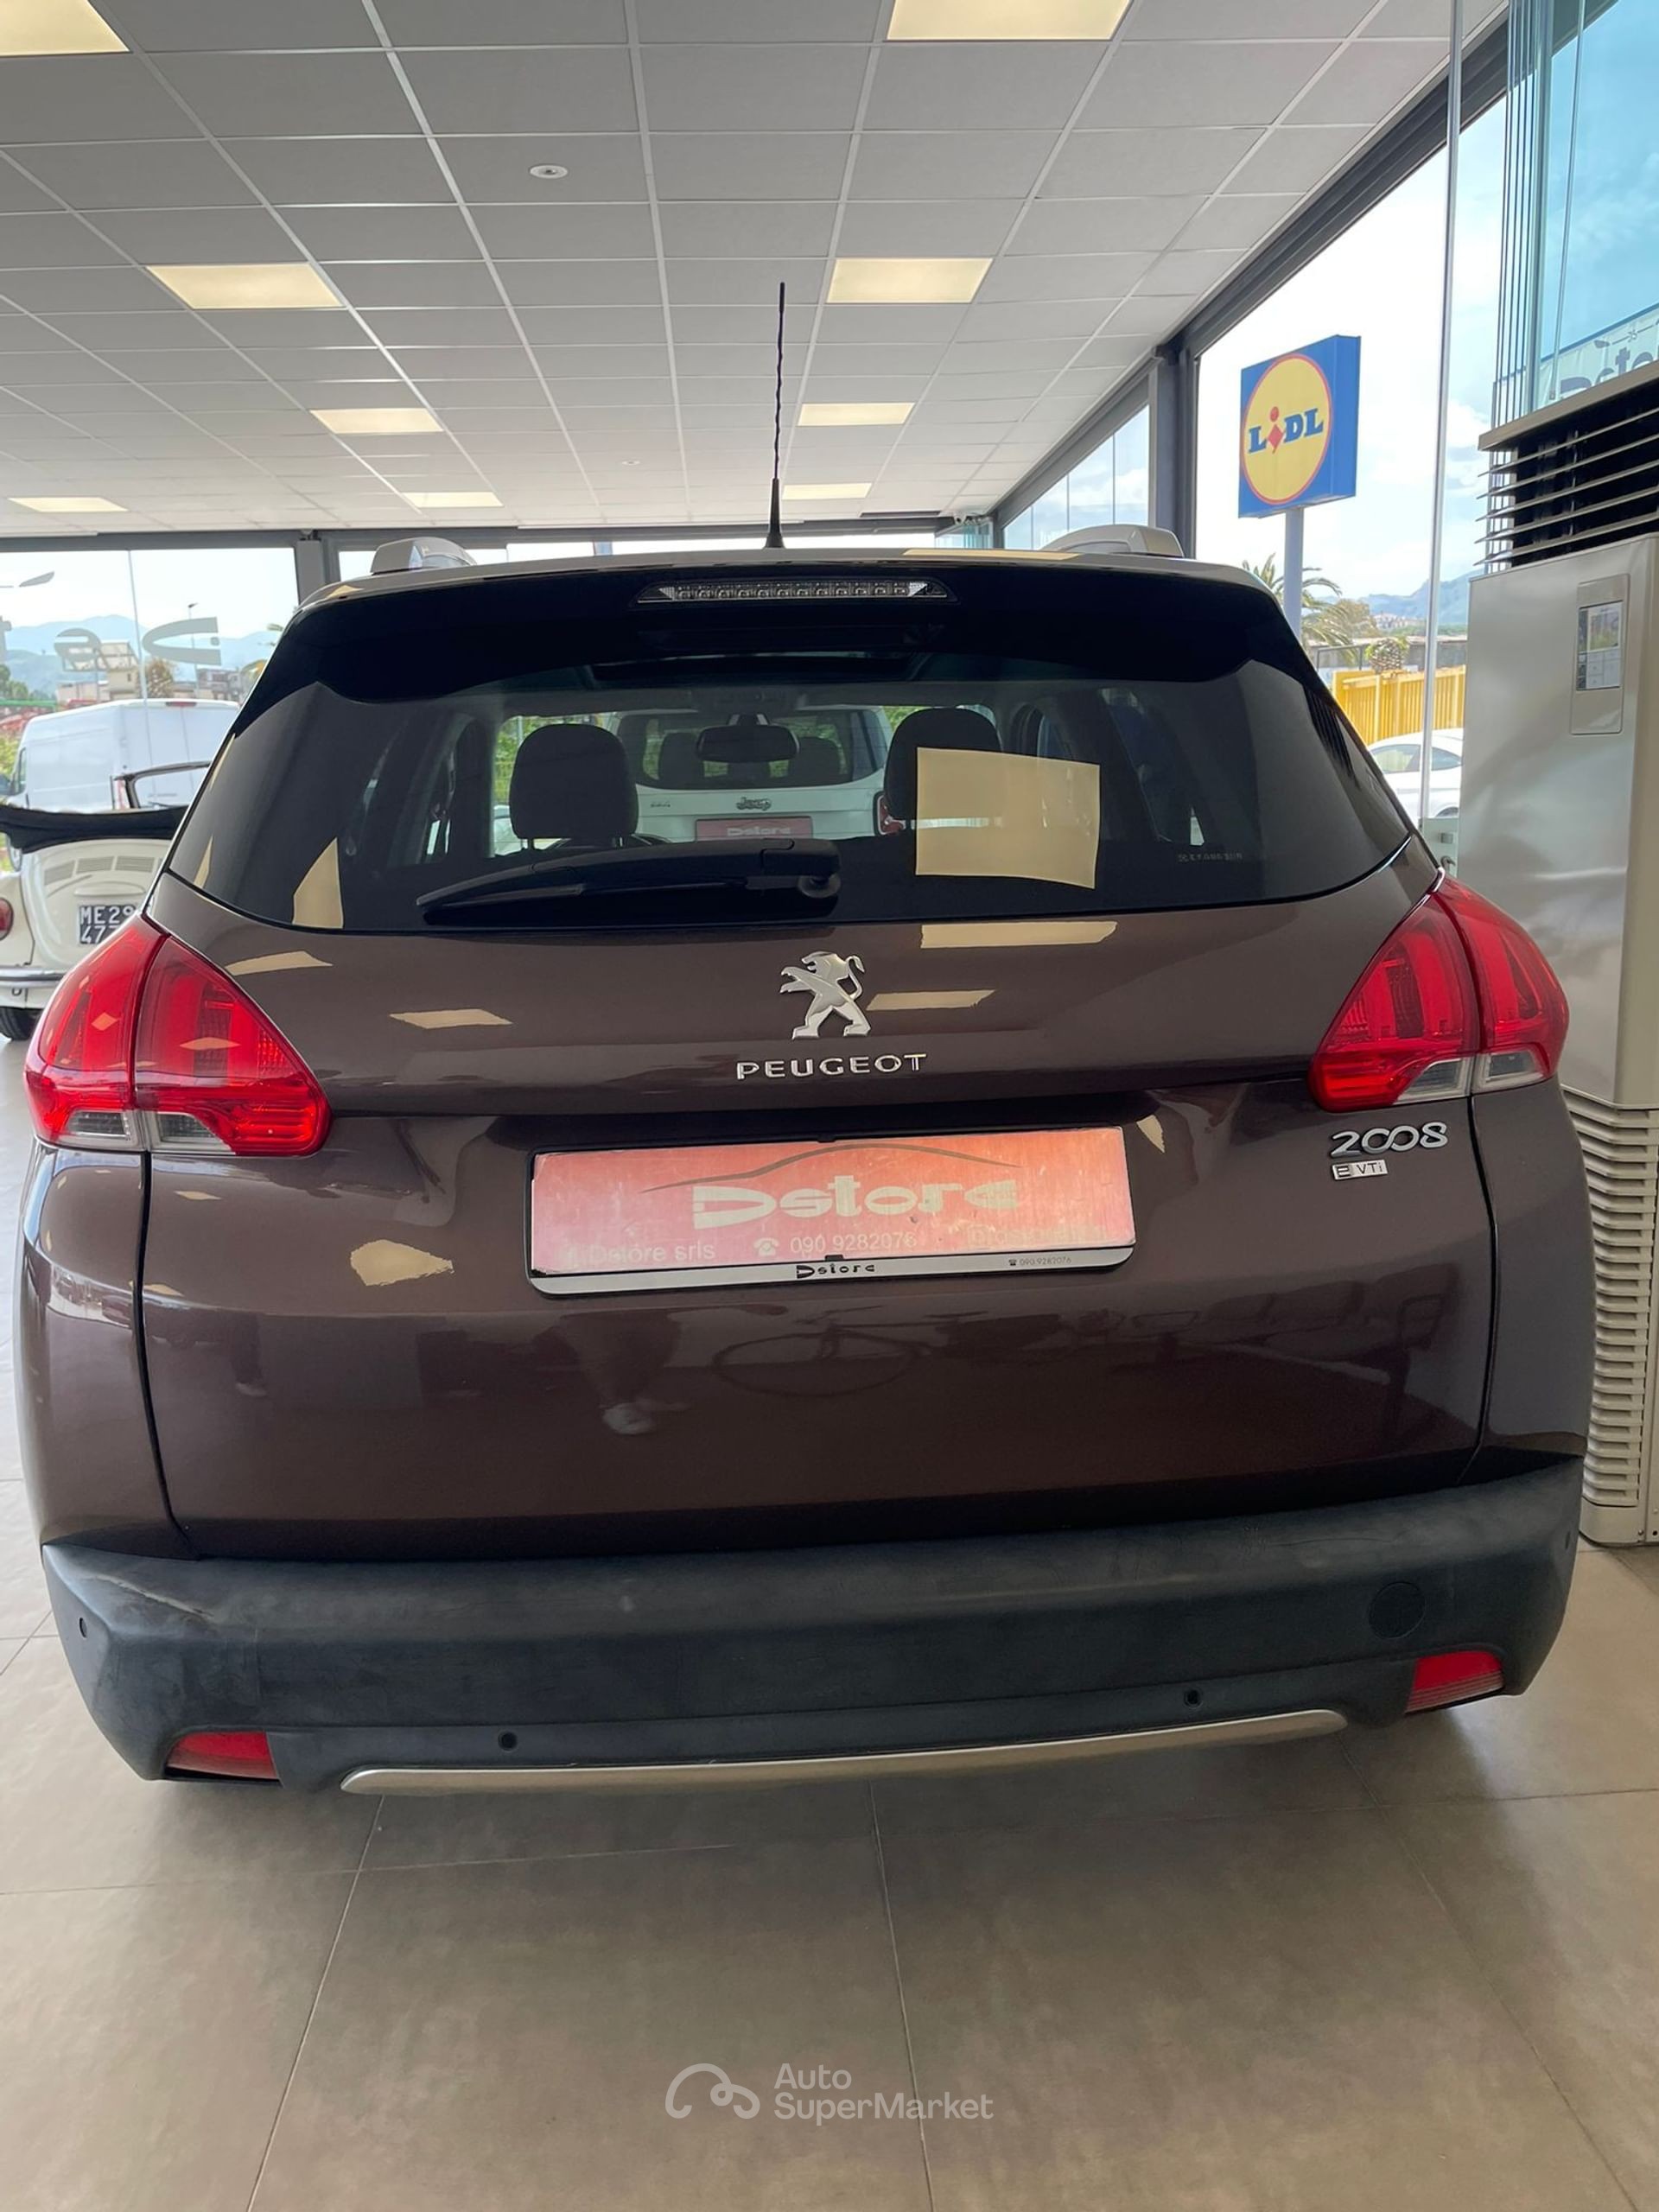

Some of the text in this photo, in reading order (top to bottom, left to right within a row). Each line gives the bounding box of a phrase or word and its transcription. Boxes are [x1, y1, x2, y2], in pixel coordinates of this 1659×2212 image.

[736, 1053, 927, 1080] PEUGEOT
[1330, 1122, 1449, 1159] 2008
[692, 1175, 1019, 1230] Dstore
[674, 1240, 716, 1261] srls
[790, 1236, 826, 1254] 090
